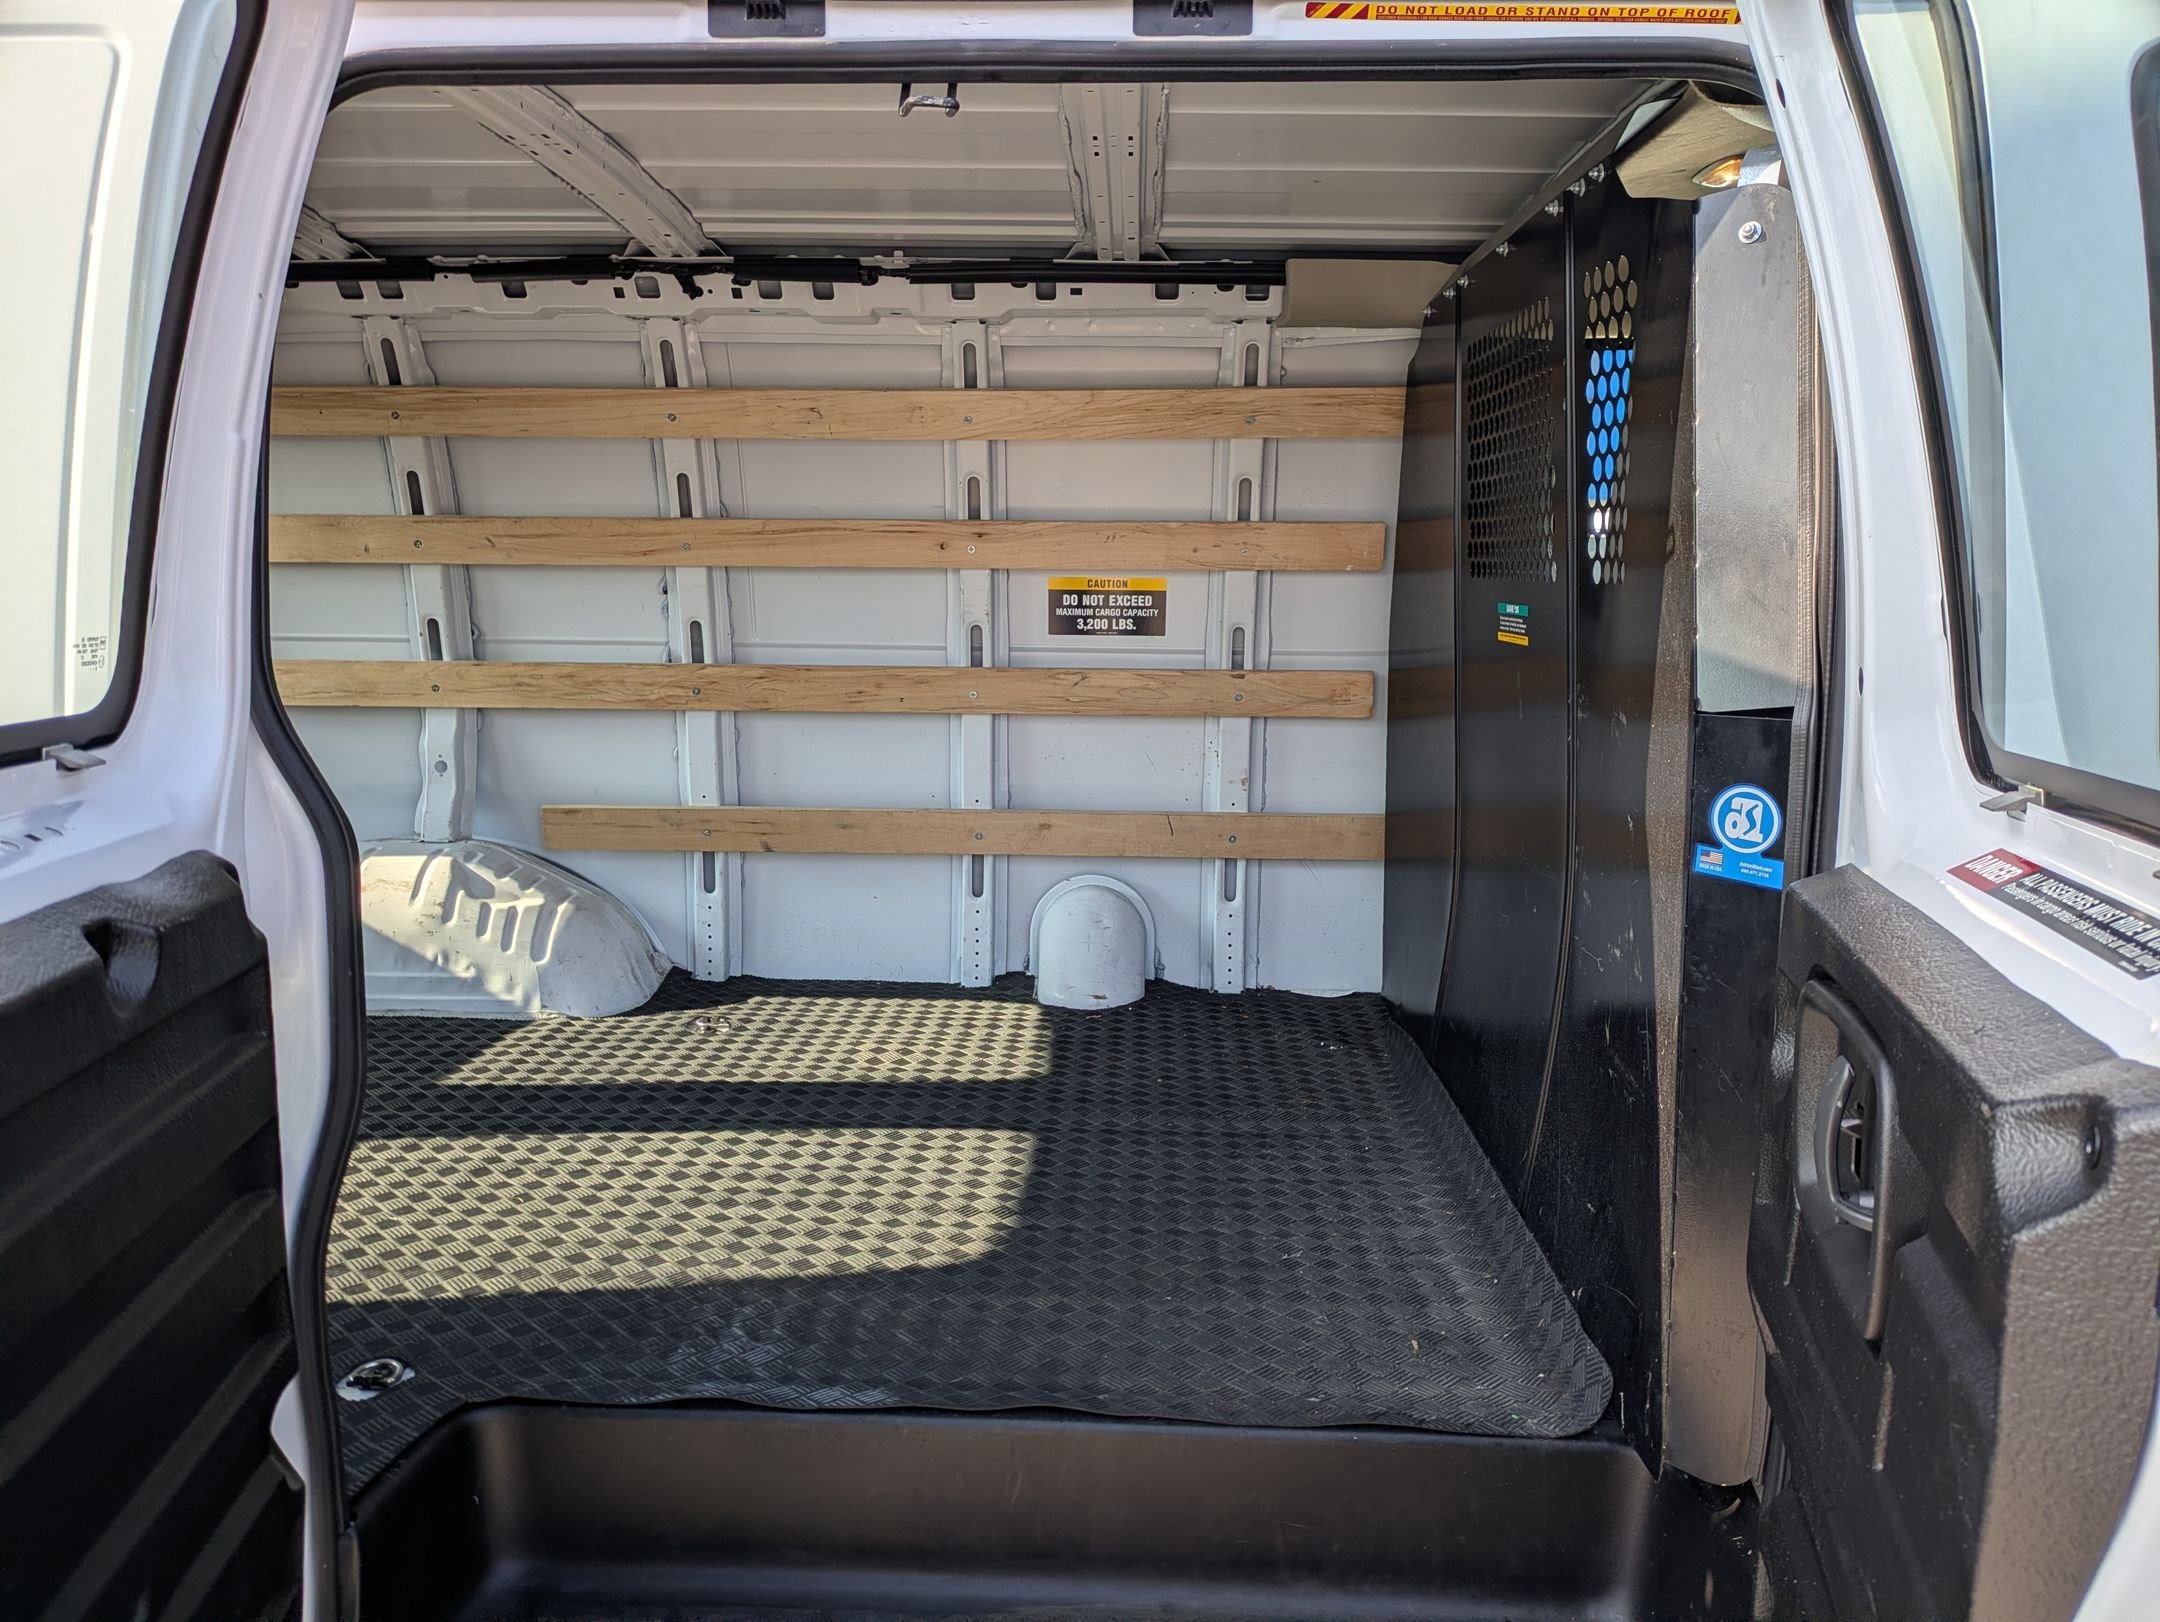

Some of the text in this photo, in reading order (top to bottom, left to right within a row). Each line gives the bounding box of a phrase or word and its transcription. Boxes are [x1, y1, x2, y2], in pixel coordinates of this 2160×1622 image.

[1376, 5, 1731, 18] DO NOT LOAD OR STAND ON TOP OF ROOF
[1087, 579, 1128, 588] CAUTION
[1063, 594, 1153, 607] DO NOT EXCEED
[1056, 608, 1159, 617] MAXIMUM CARGO CAPACITY
[1077, 619, 1137, 631] 3,200 LBS.
[1964, 855, 2024, 884] DANGER
[2001, 882, 2039, 902] Passengers
[2020, 873, 2160, 943] ALL PASSENGERS MUST RIDE IN
[2036, 901, 2061, 914] cargo
[2053, 909, 2080, 924] areas
[2070, 919, 2096, 933] risk
[2083, 926, 2117, 945] serious
[2108, 939, 2126, 949] or
[2116, 942, 2149, 959] fatal
